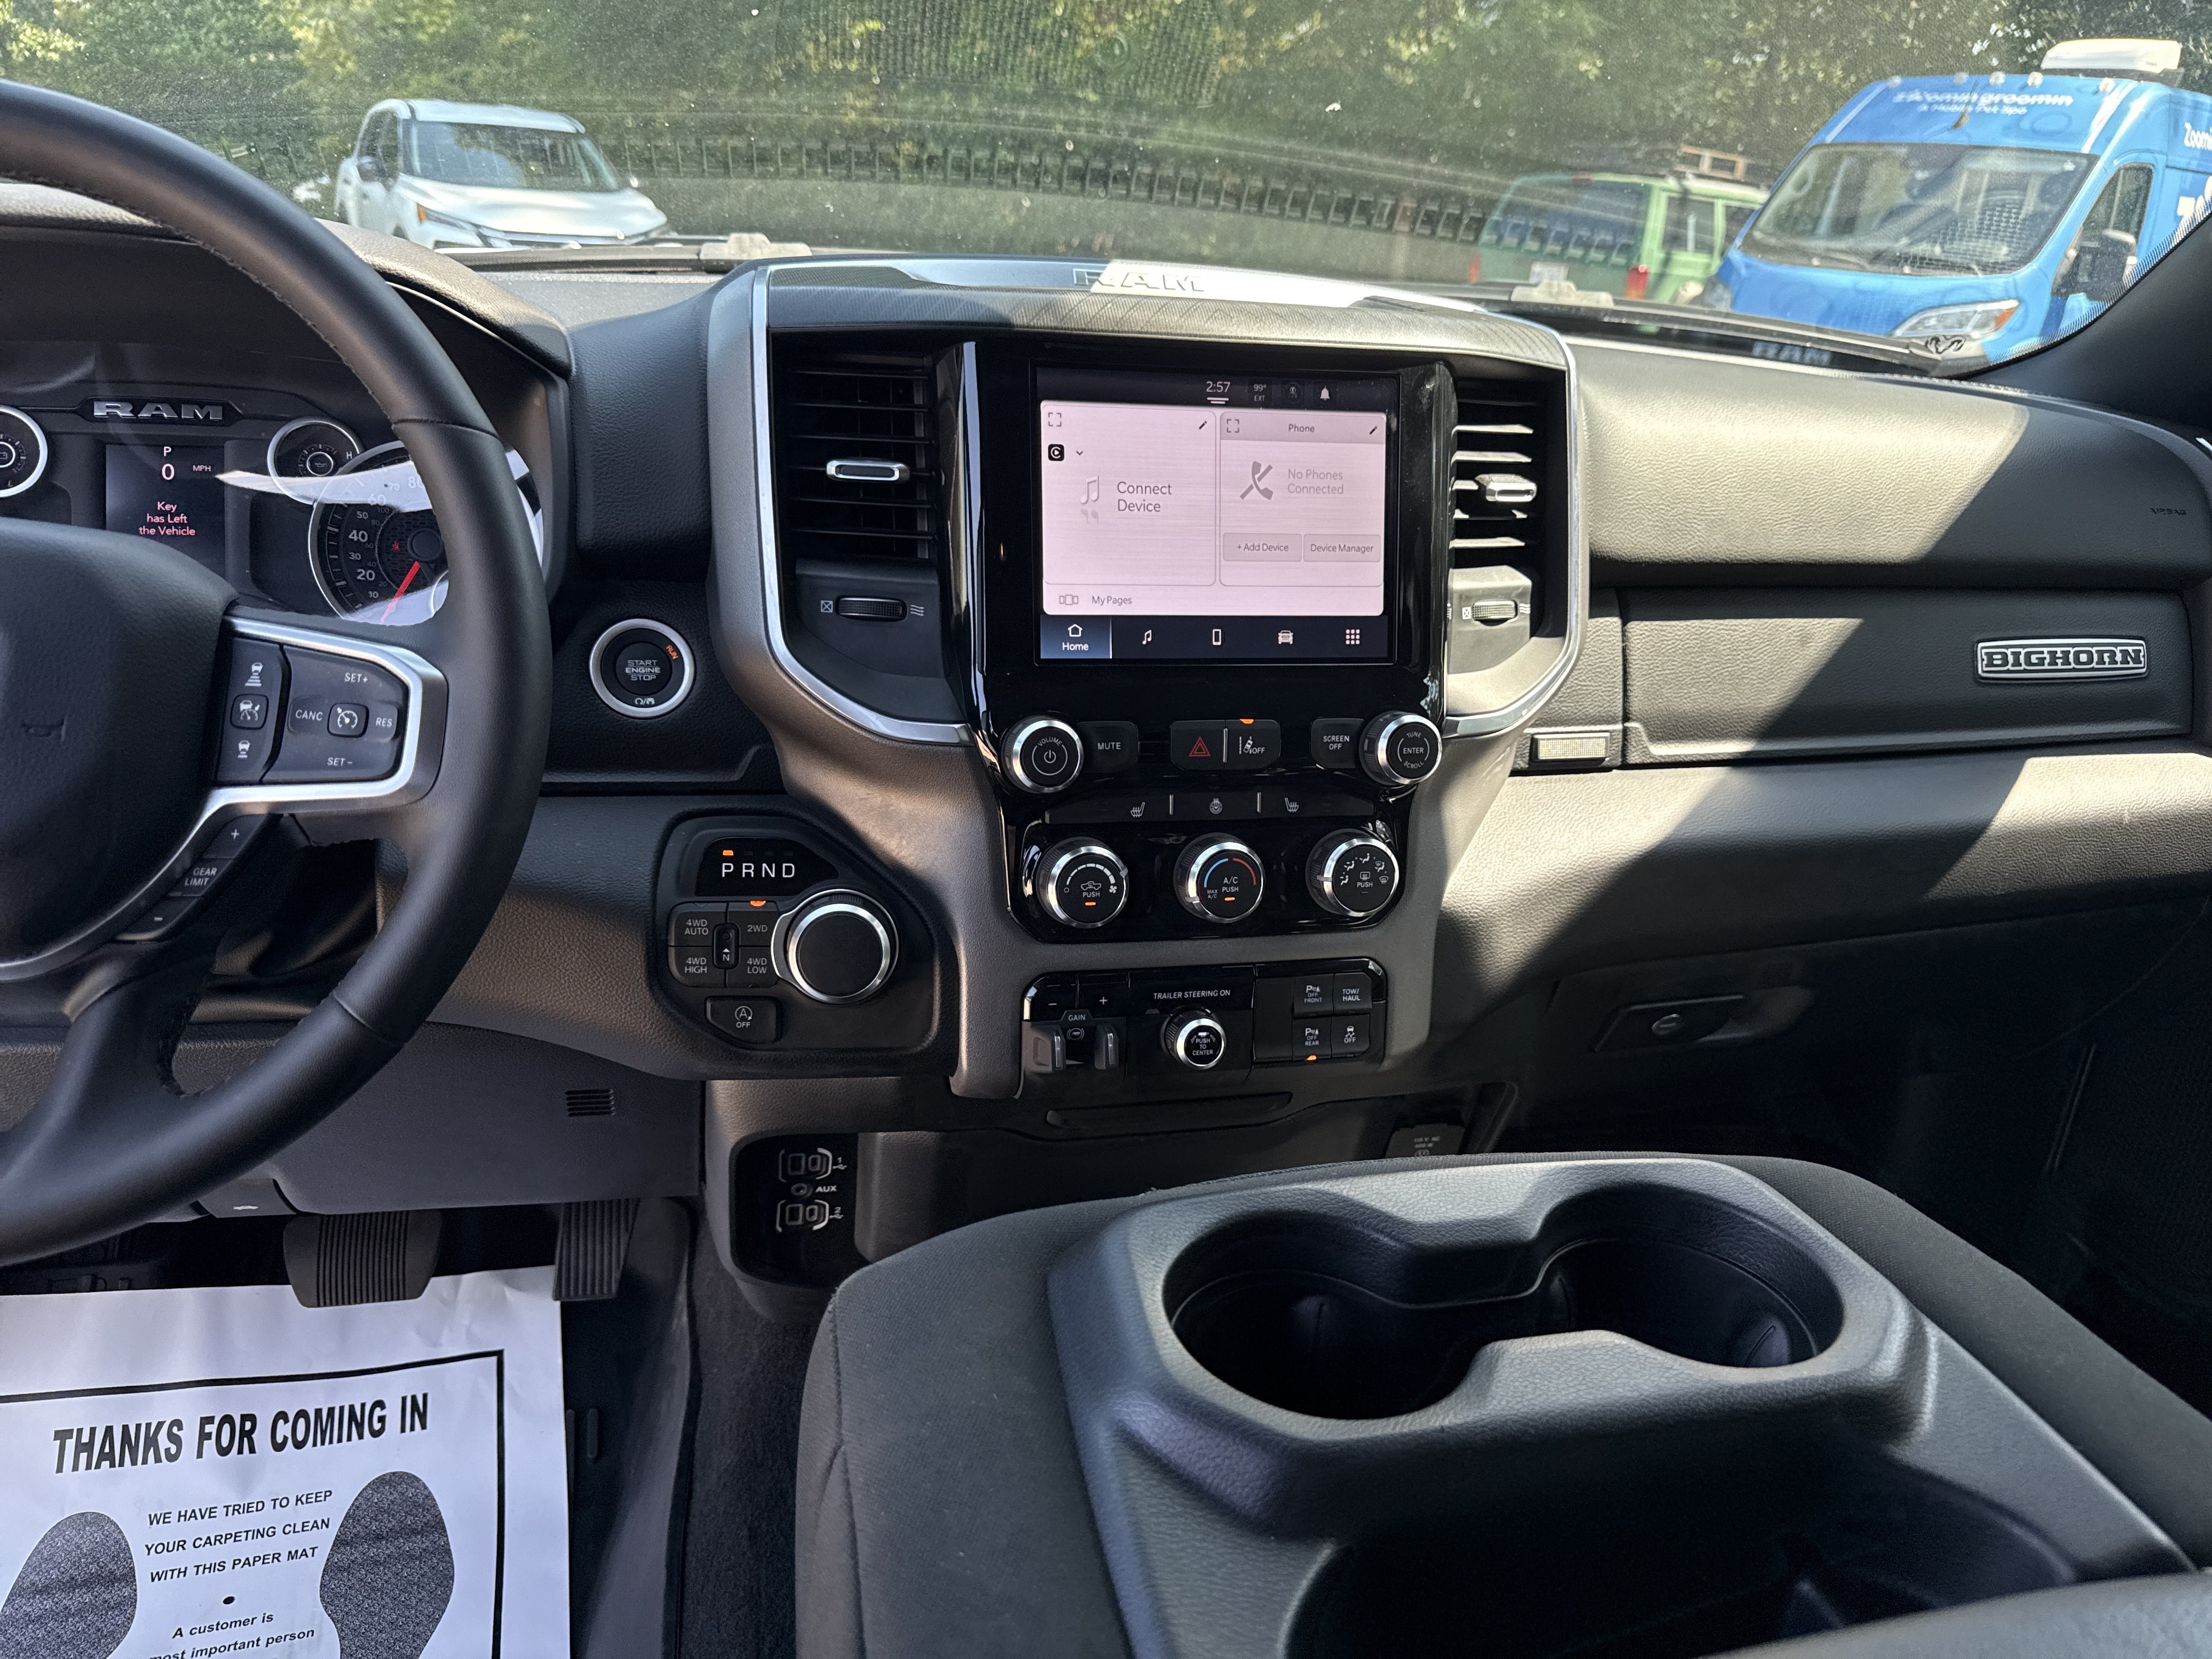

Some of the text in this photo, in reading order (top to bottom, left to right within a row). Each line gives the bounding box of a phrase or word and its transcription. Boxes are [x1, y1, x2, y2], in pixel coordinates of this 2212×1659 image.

[1073, 268, 1205, 292] RAM
[1206, 381, 1231, 393] 2:57
[93, 401, 223, 420] RAM
[1288, 424, 1315, 433] Phone
[163, 447, 171, 456] P
[1288, 469, 1343, 482] No Phones
[388, 483, 400, 491] 70
[1116, 481, 1172, 495] Connect
[1288, 483, 1344, 495] Connected
[157, 501, 177, 512] Key
[1118, 499, 1161, 512] Device
[147, 514, 188, 523] has Left
[139, 526, 196, 535] the Vehicle
[348, 530, 368, 542] 40
[1243, 543, 1261, 551] Add
[1262, 543, 1289, 551] Device
[1310, 544, 1374, 555] Device Manager
[357, 569, 375, 581] 20
[1092, 596, 1132, 606] My Pages
[665, 645, 679, 659] RUN
[1062, 642, 1089, 651] Home
[1982, 646, 2144, 672] BIGHORN
[295, 709, 323, 721] CANC
[375, 717, 392, 727] RES
[1039, 736, 1063, 747] VOLUME
[1403, 760, 1424, 769] SCROLL
[193, 867, 217, 876] GEAR
[723, 863, 795, 877] P R N D
[185, 878, 210, 886] LIMIT
[1154, 991, 1182, 1000] TRAILER
[1183, 990, 1218, 998] STEERING
[53, 1393, 428, 1474] THANKS FOR COMING IN
[148, 1490, 333, 1526] WE HAVE TRIED TO KEEP
[144, 1517, 330, 1556] YOUR CARPETING CLEAN
[150, 1546, 318, 1583] WITH THIS PAPER MAT
[172, 1612, 274, 1639] A customer is
[190, 1637, 261, 1658] important
[266, 1629, 314, 1649] person
